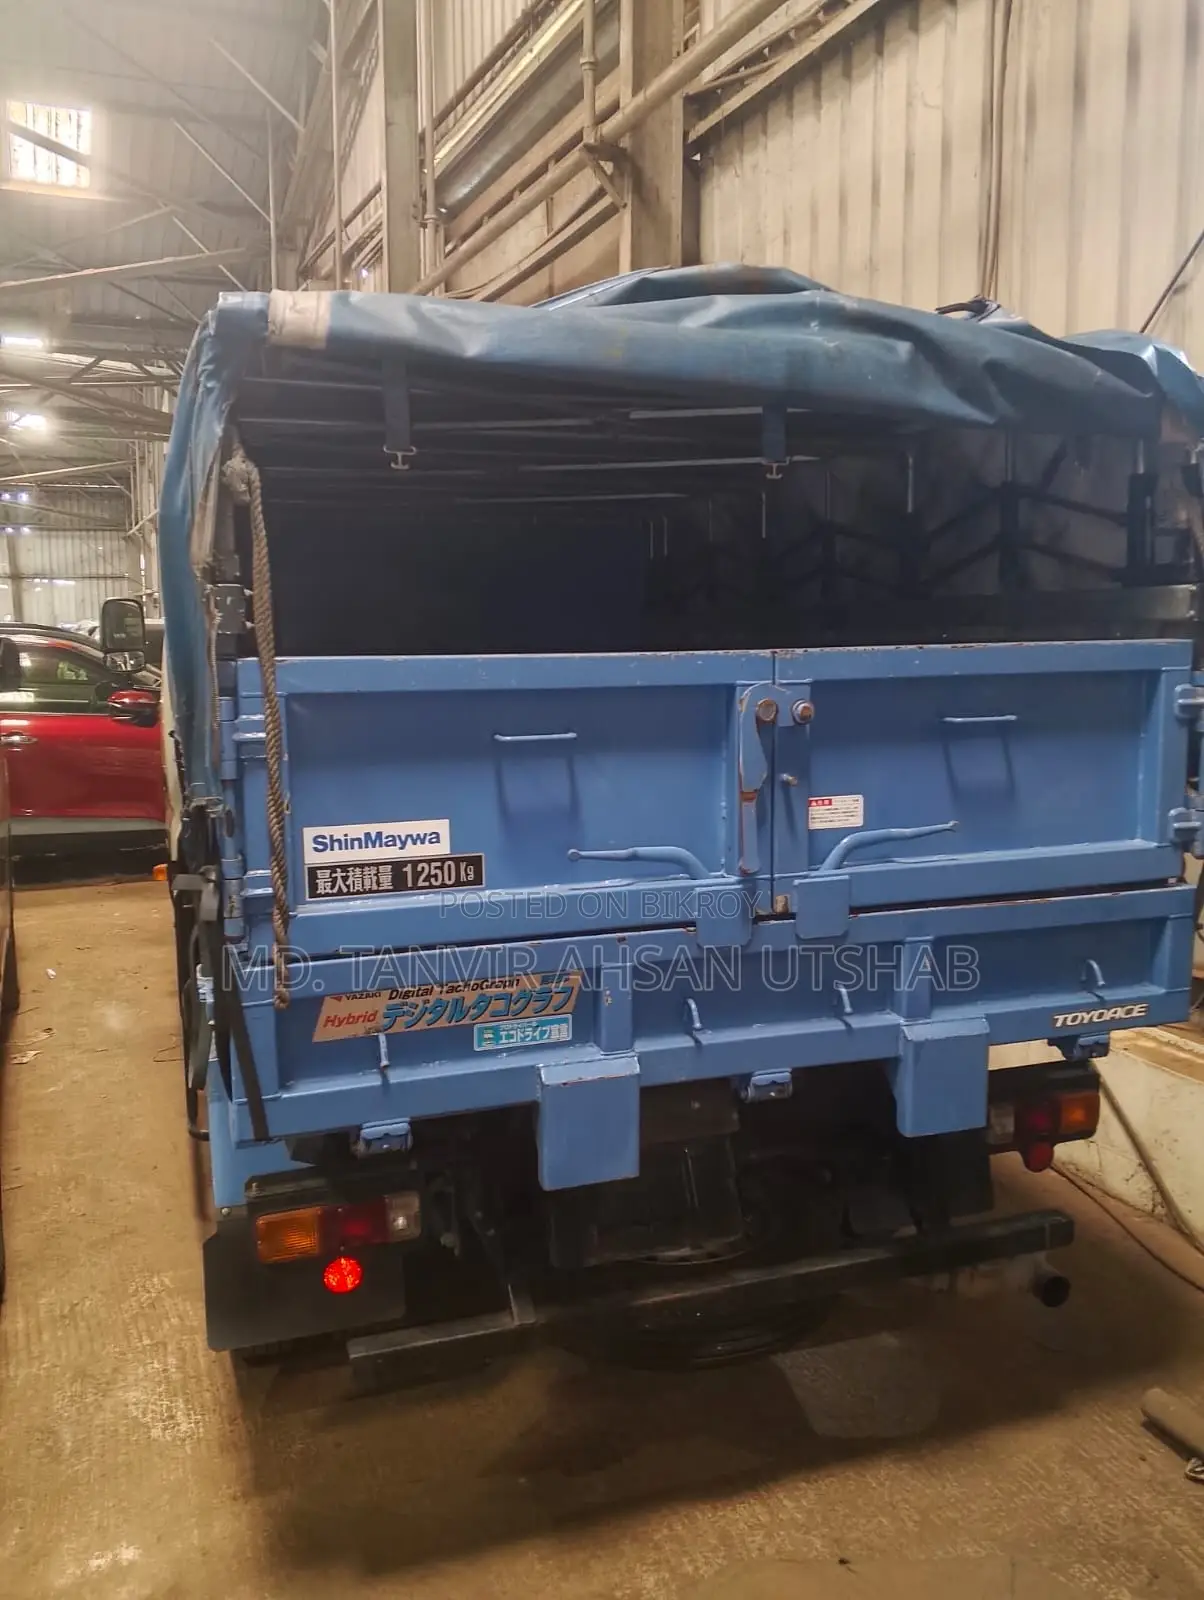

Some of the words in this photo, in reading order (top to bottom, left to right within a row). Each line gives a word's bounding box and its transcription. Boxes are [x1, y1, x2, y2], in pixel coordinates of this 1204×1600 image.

[312, 831, 441, 852] ShinMaywa
[315, 865, 394, 895] 最大積載量
[402, 861, 457, 888] 1250
[459, 861, 475, 882] Kg
[388, 985, 434, 1001] Digital
[322, 1010, 379, 1028] Hybrid
[381, 986, 574, 1032] デジタルタコグラフ
[1053, 1003, 1150, 1028] TOYOACE
